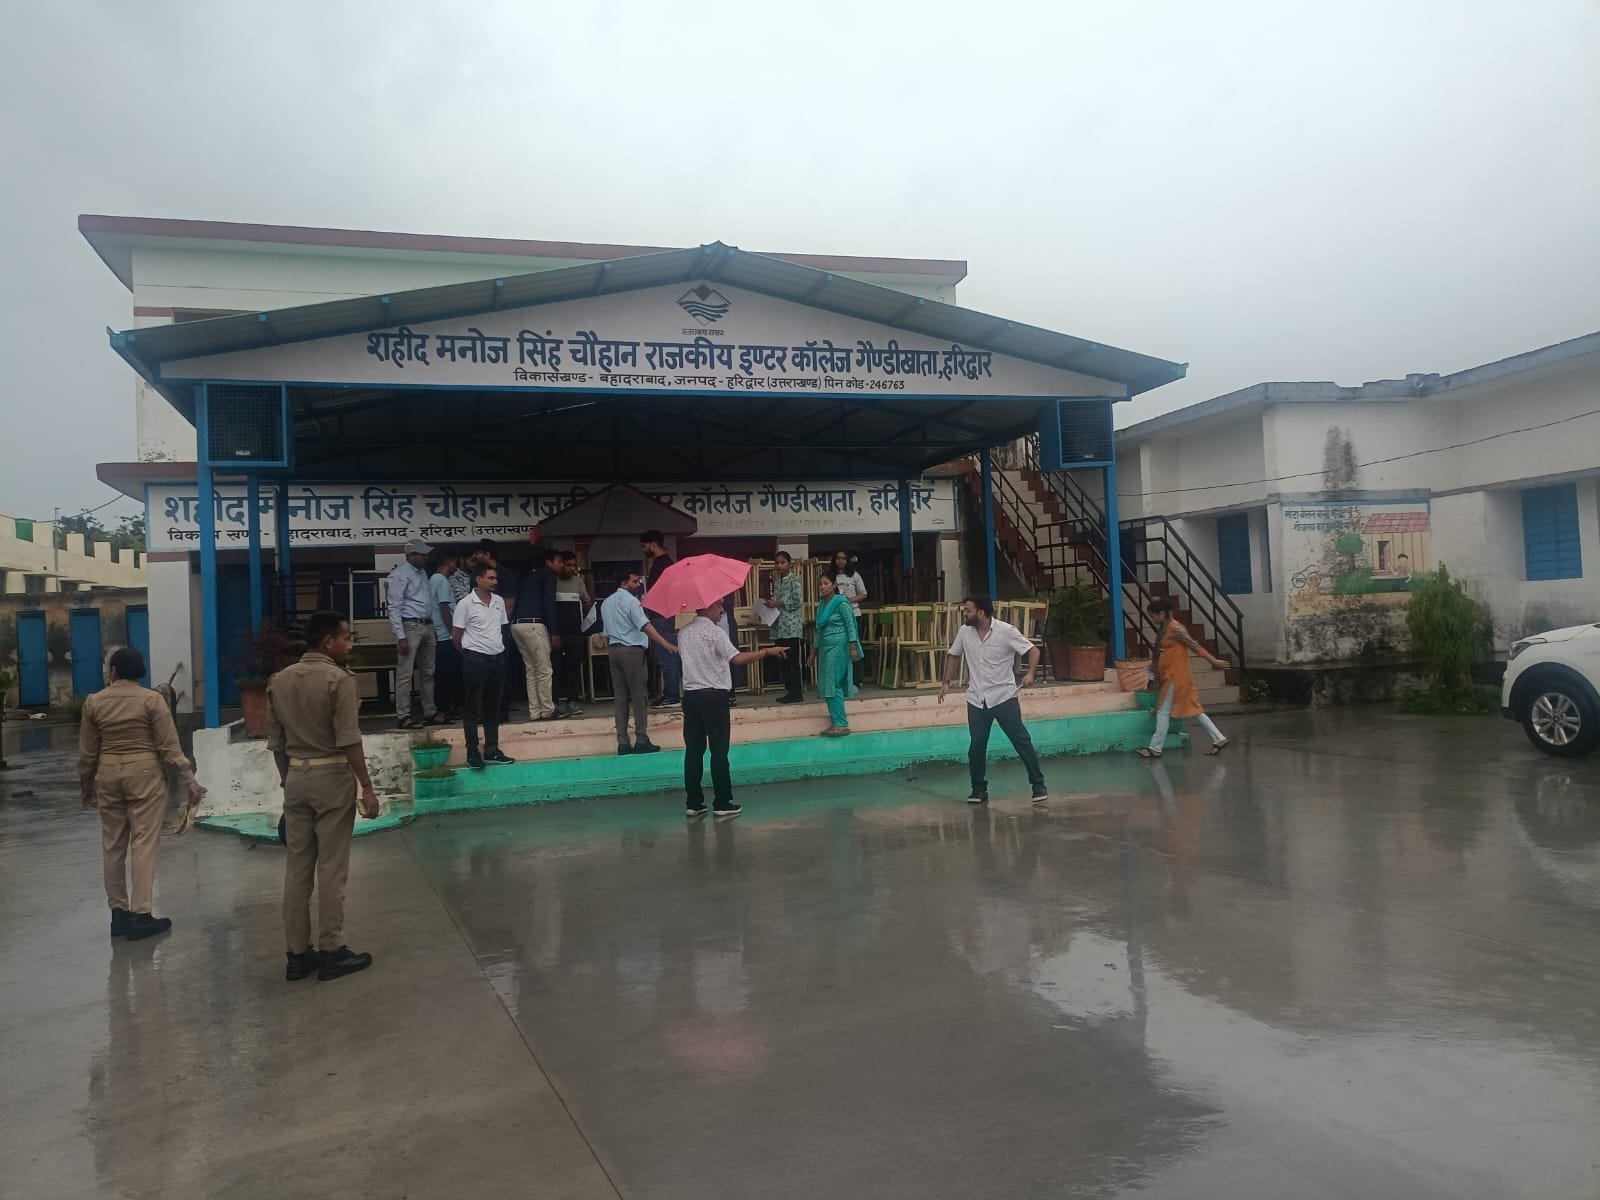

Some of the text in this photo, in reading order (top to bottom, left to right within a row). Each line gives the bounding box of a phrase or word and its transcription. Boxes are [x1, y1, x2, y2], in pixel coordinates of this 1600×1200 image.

[367, 327, 430, 368] शहीद
[436, 328, 510, 364] मनोज
[517, 329, 563, 372] सिंह
[568, 330, 640, 373] चौहान
[645, 336, 735, 371] राजकीय
[739, 344, 787, 376] इण्टर
[791, 340, 853, 373] कॉलेज
[726, 373, 765, 390] हरिद्वार
[824, 375, 843, 389] पिन
[360, 487, 417, 523] सिंह
[423, 485, 513, 521] चौहान
[683, 485, 753, 515] कॉलेज
[757, 483, 863, 517] गैण्डीखाता,
[419, 523, 466, 540] हरिद्वार
